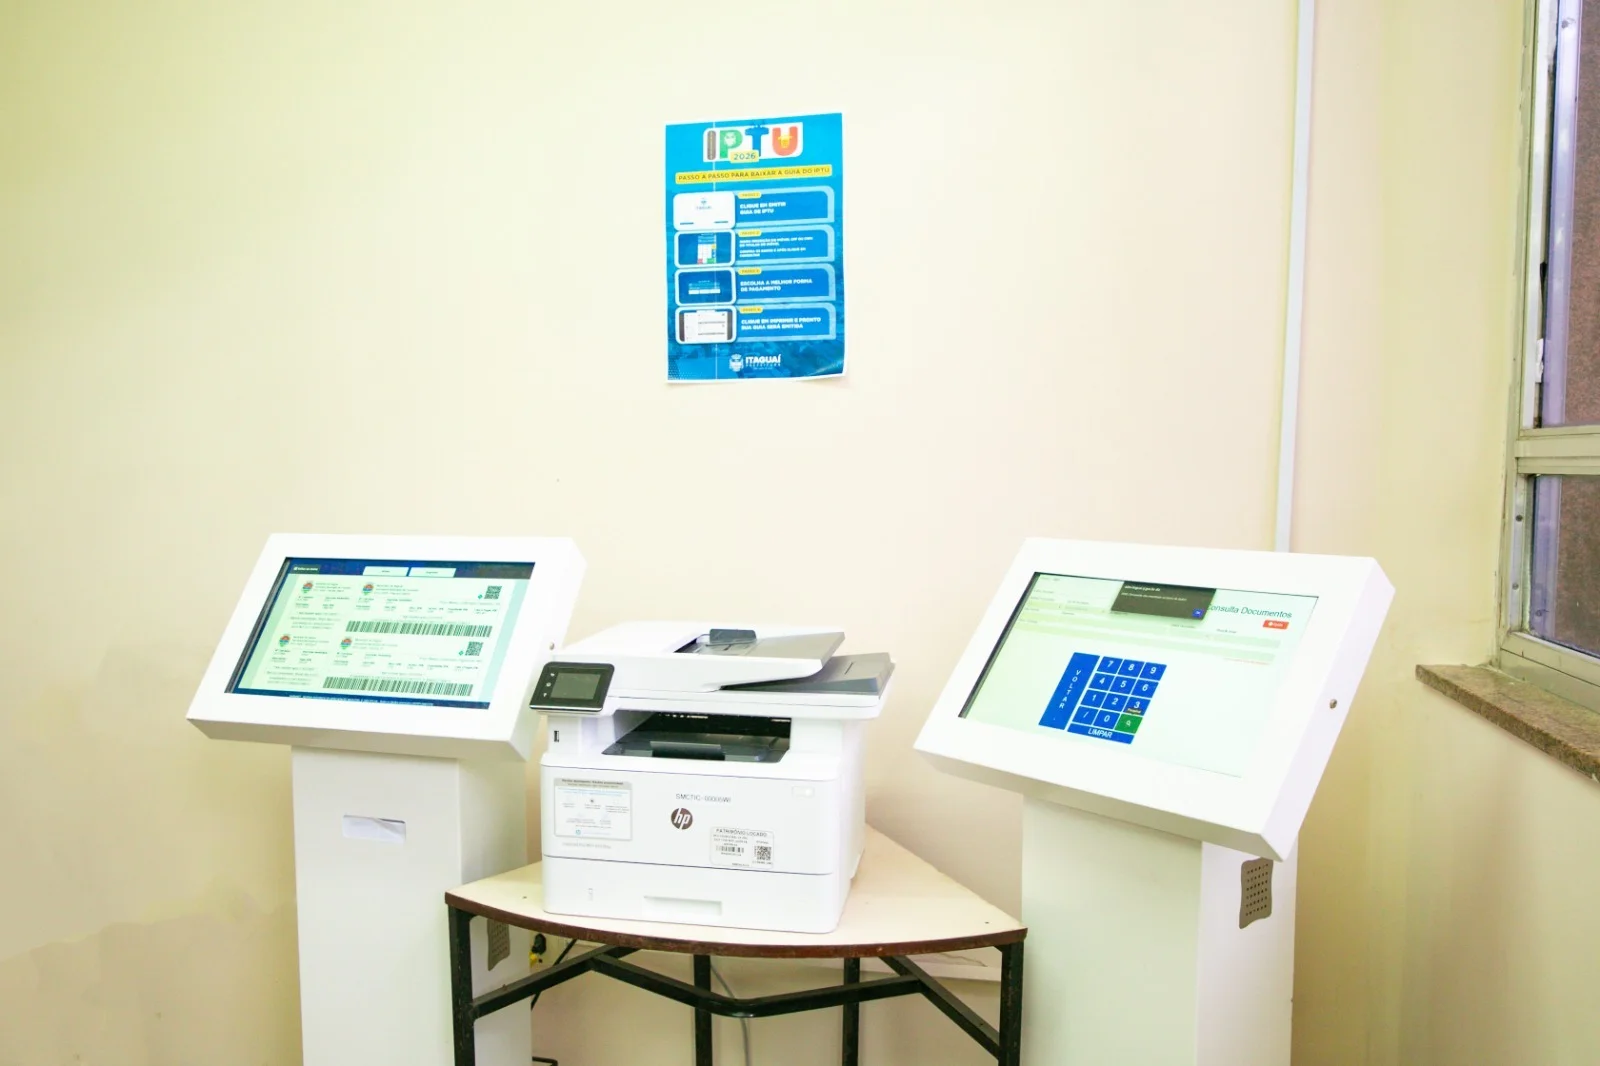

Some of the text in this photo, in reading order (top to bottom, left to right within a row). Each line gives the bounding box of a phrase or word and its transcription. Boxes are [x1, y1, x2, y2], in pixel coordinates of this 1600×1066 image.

[707, 126, 798, 160] IPTU
[733, 152, 756, 160] 2026
[745, 353, 782, 363] ITAGUAÍ
[1241, 606, 1292, 618] Documentos
[1059, 670, 1081, 709] VOLTAR
[1111, 697, 1119, 705] 2
[1088, 728, 1113, 738] LIMPAR
[674, 808, 691, 829] hp
[716, 828, 746, 836] PATRIMÔNIO
